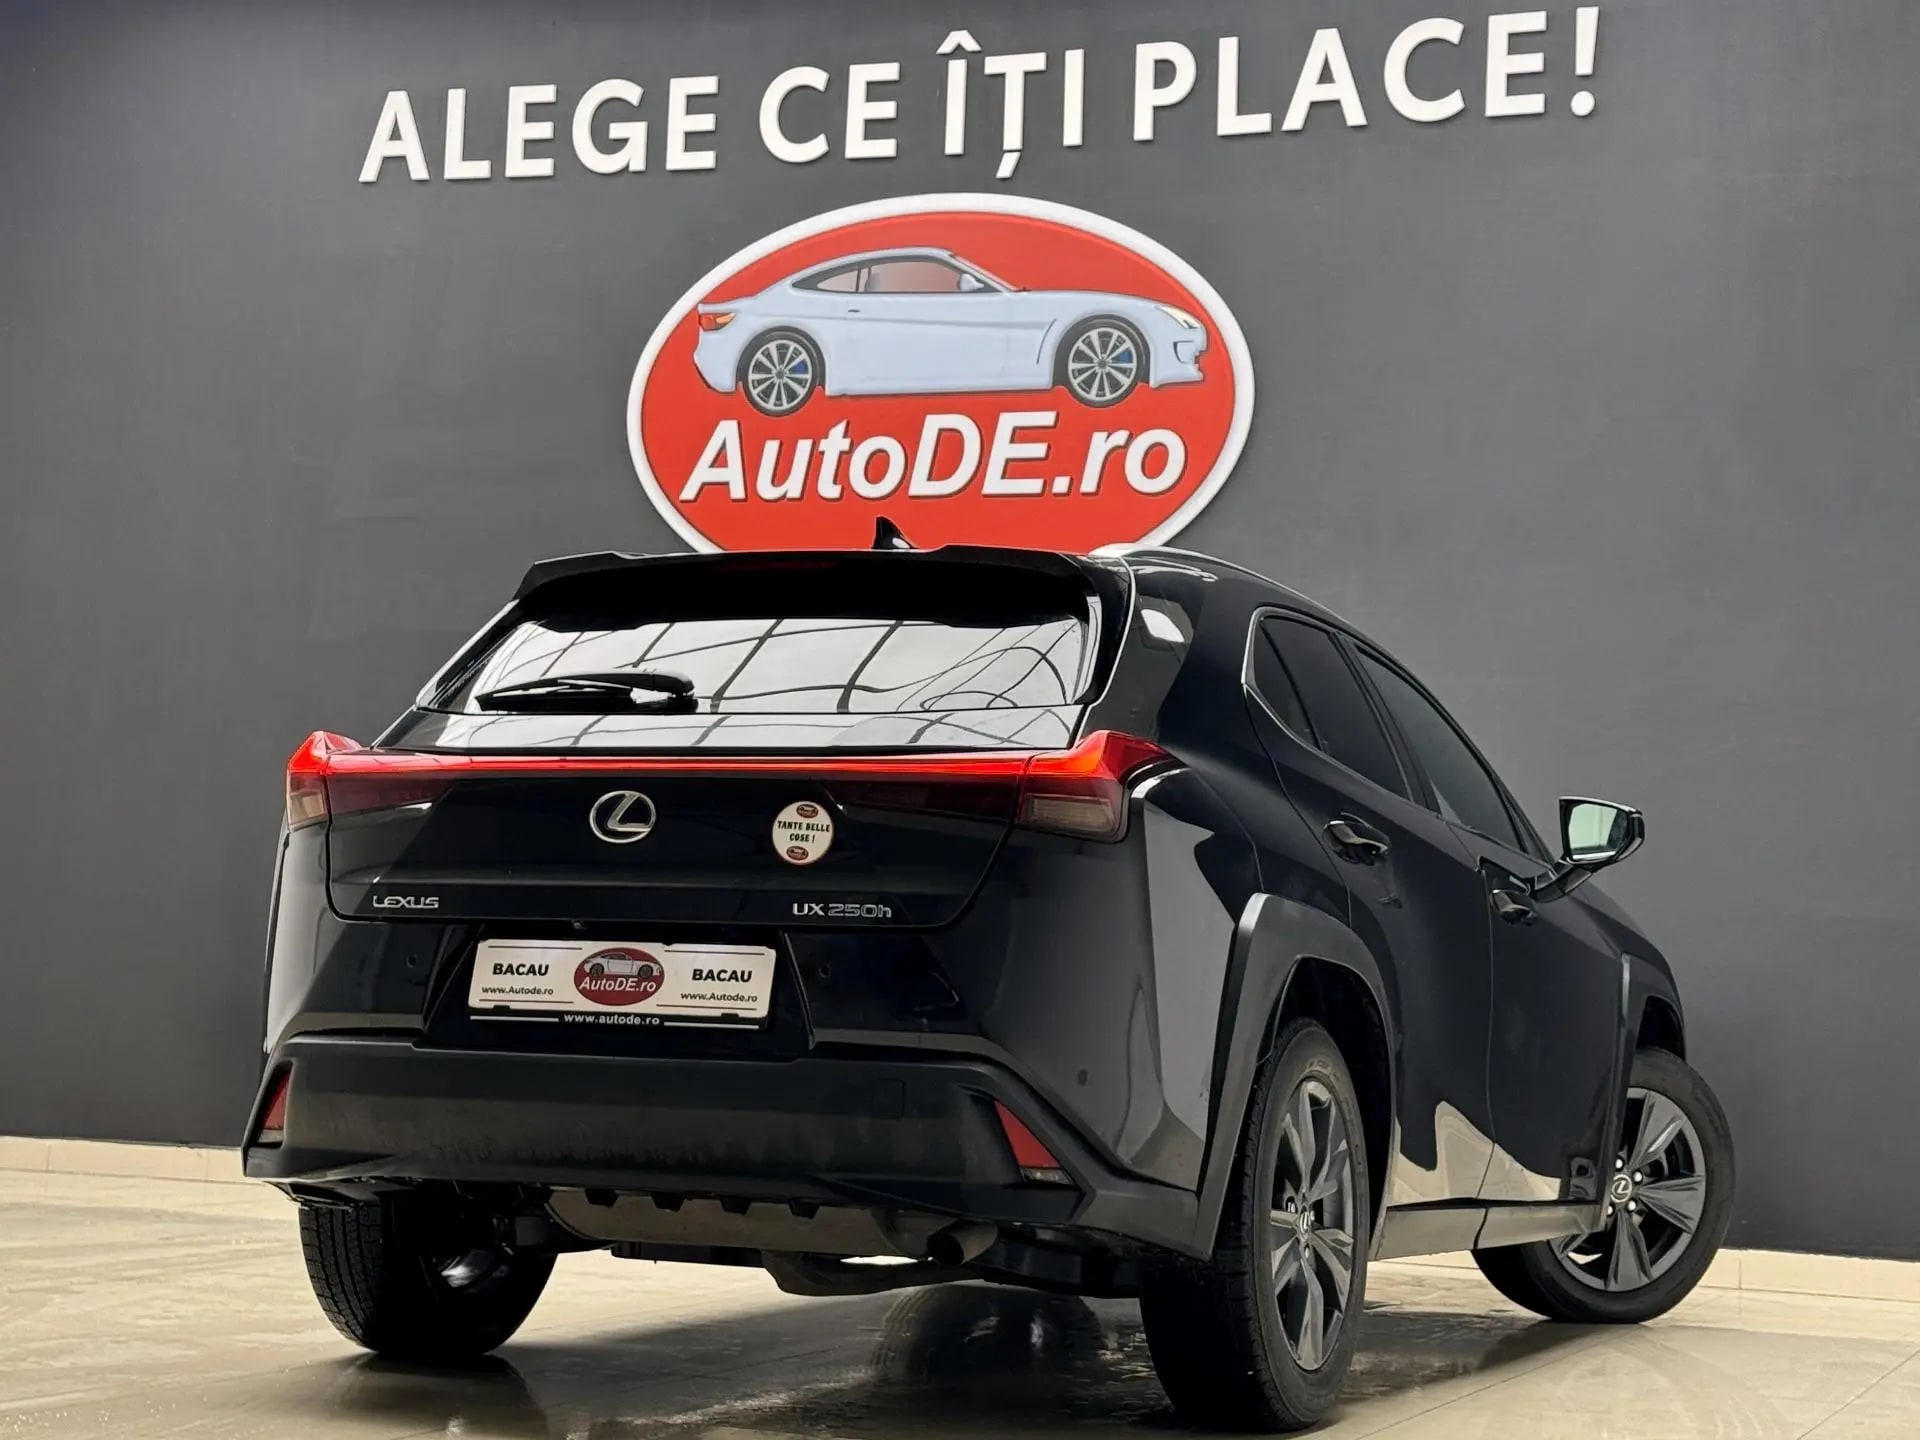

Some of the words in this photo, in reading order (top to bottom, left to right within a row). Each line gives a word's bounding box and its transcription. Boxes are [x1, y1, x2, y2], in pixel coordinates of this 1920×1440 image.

[358, 75, 719, 183] ALEGE
[759, 62, 900, 164] CE
[1133, 6, 1599, 141] PLACE!
[679, 410, 1186, 502] AutoDE.ro
[777, 821, 803, 830] TANTE
[805, 823, 830, 832] BELLE
[789, 833, 810, 842] COSE
[373, 895, 439, 908] LEXUS
[792, 903, 825, 916] UX
[827, 903, 892, 918] 250h
[492, 963, 549, 976] BACAU
[692, 969, 752, 982] BACAU
[481, 985, 554, 996] www.Autode.ro
[579, 976, 657, 992] AutoDE.ro
[680, 991, 758, 1003] www.Autode.ro
[563, 1013, 661, 1025] www.autode.ro
